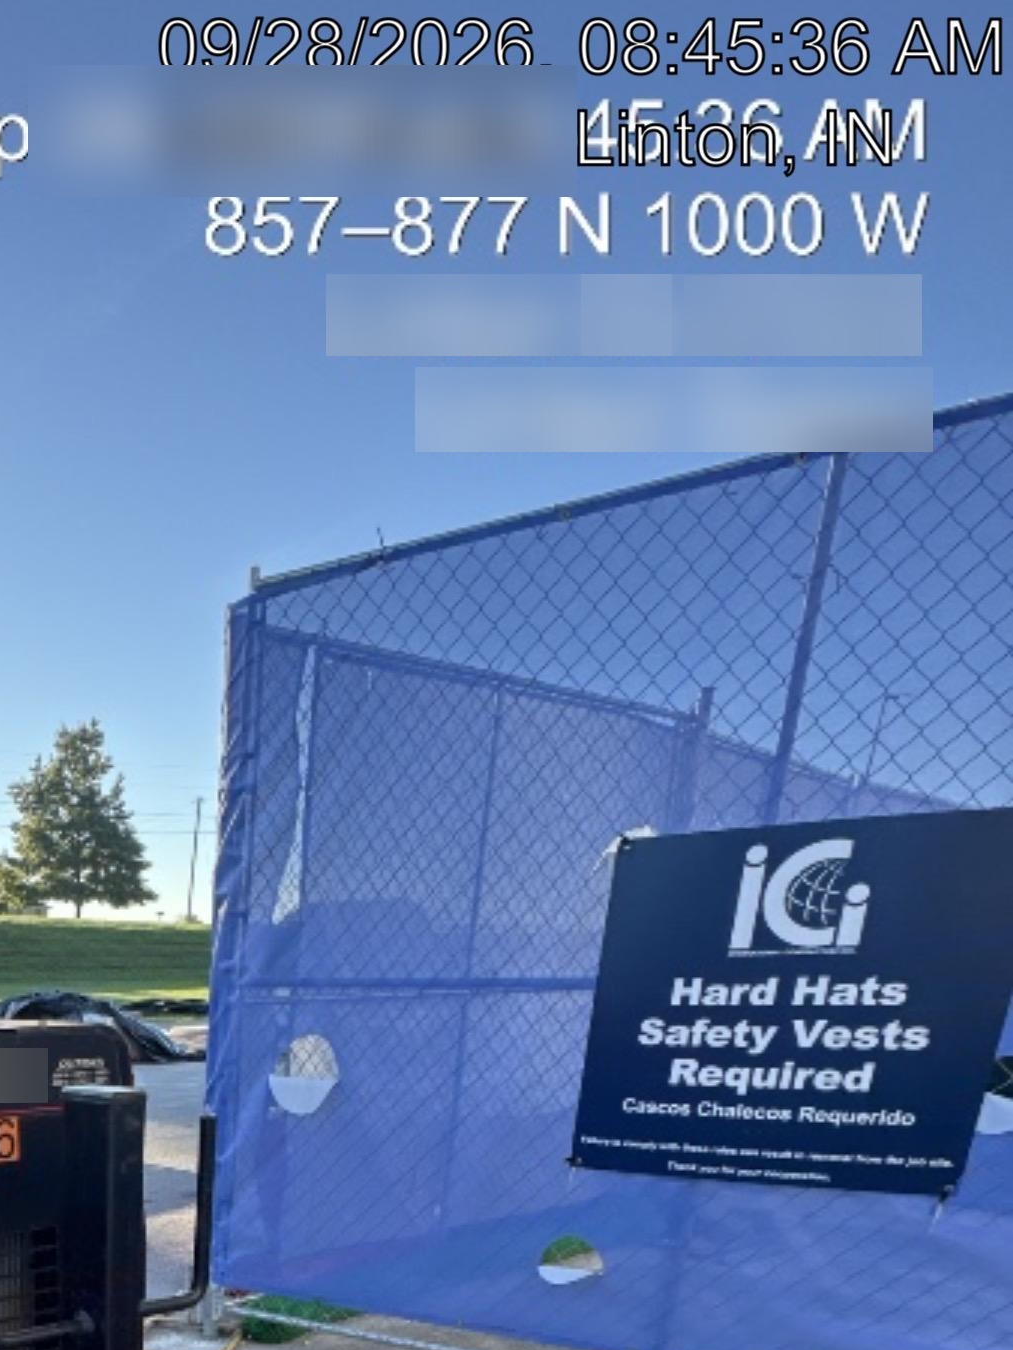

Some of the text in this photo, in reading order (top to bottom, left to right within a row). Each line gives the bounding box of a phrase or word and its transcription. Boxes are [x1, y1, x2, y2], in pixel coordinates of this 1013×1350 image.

[670, 975, 909, 1006] Hard Hats
[637, 1017, 931, 1055] Safety Vests
[668, 1057, 876, 1096] Required
[622, 1097, 916, 1127] Cascos Chalecos Requerido
